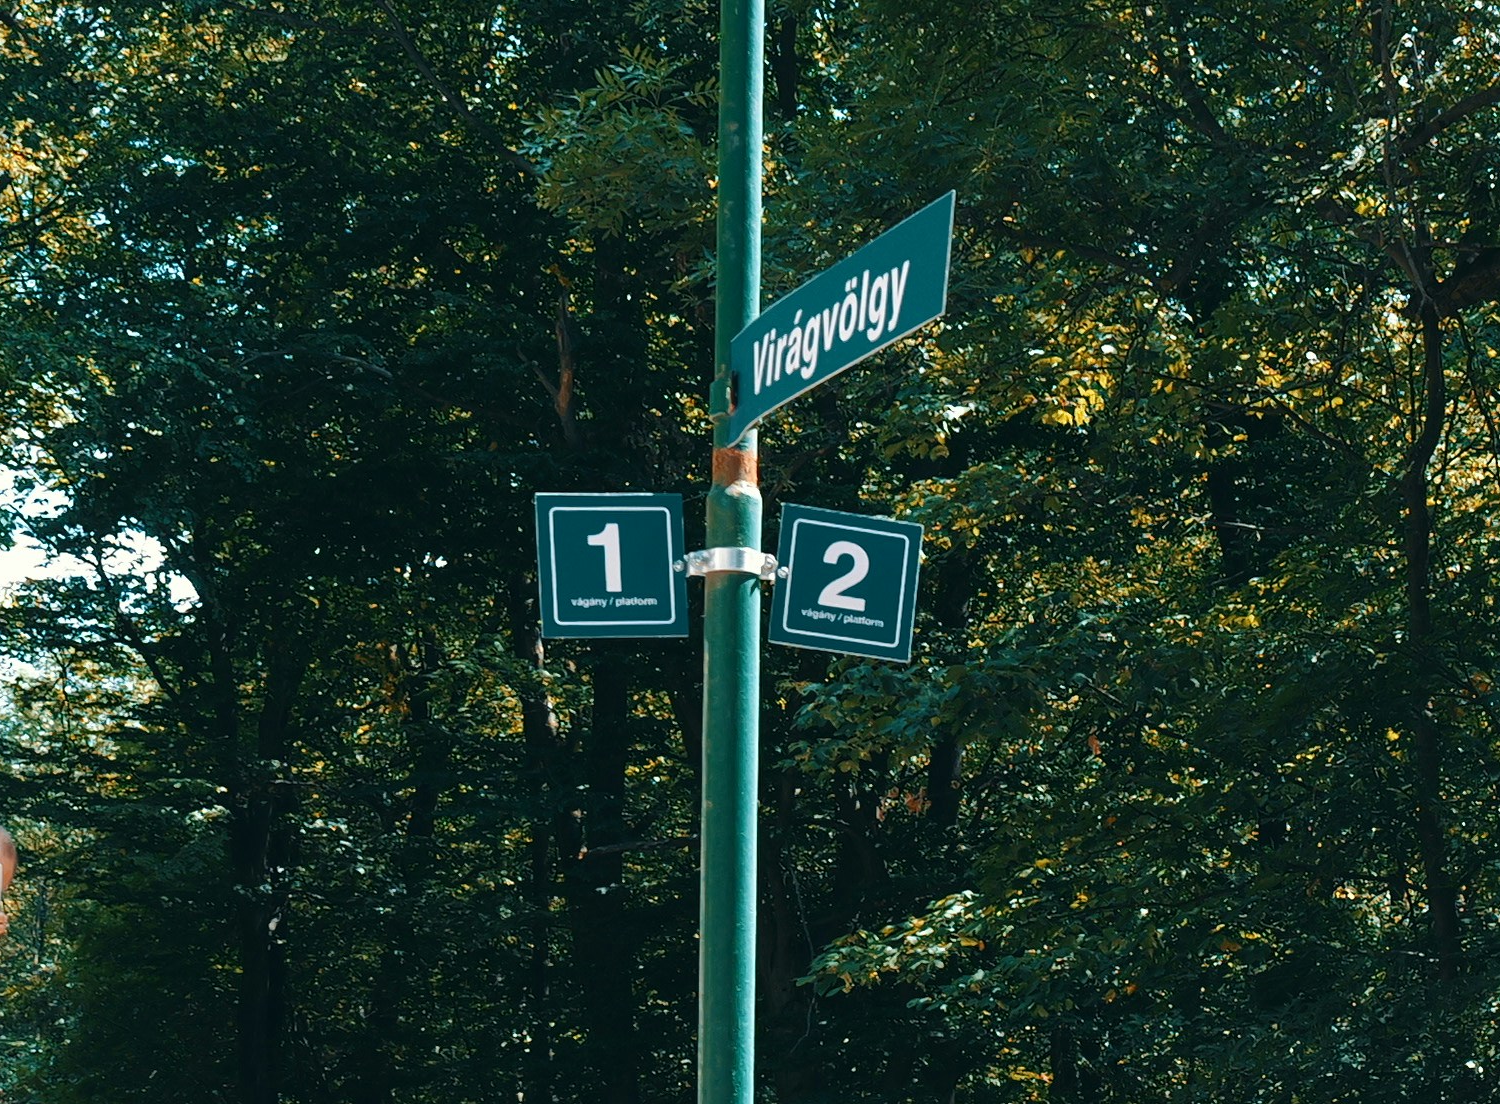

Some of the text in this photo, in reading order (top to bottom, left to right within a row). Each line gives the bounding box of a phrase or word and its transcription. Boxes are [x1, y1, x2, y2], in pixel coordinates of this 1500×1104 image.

[753, 259, 911, 396] Virágvölgy
[587, 523, 622, 592] 1
[817, 541, 869, 611] 2
[615, 597, 658, 607] platform
[843, 614, 884, 628] platform
